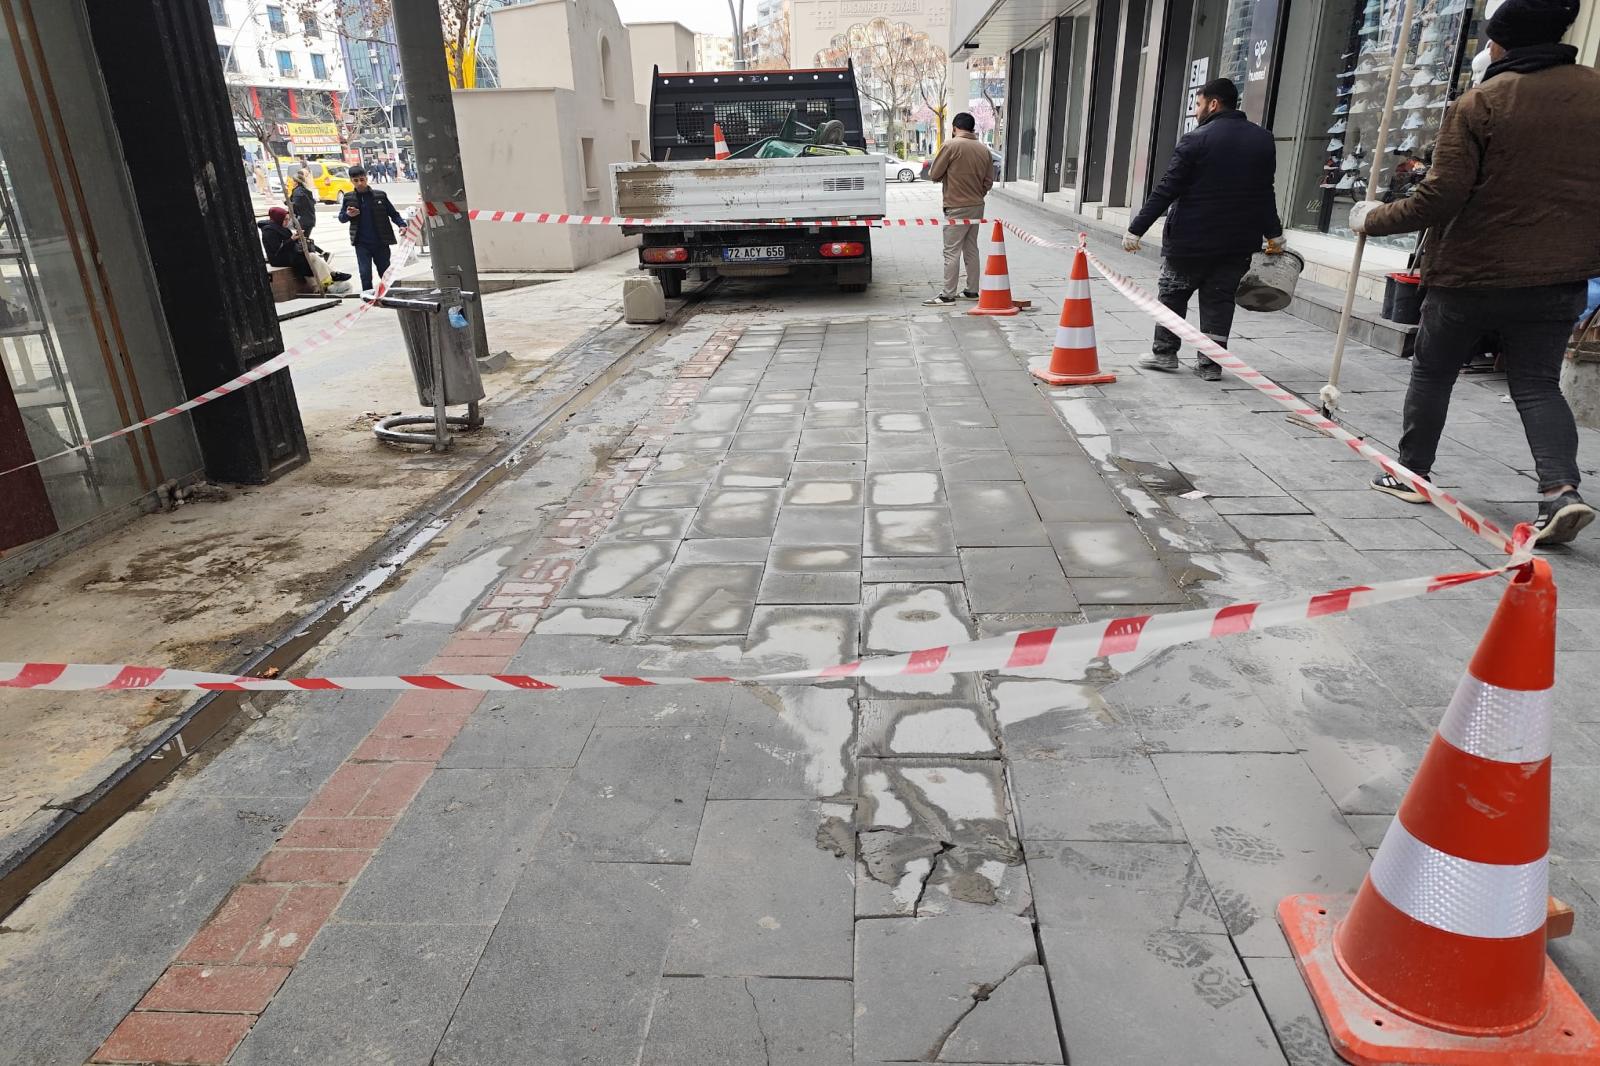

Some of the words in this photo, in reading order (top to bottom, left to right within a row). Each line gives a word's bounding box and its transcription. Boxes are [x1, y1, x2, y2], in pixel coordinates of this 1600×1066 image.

[1192, 64, 1198, 82] 3
[1188, 94, 1194, 111] 2
[729, 248, 740, 258] 72
[744, 247, 762, 258] ACY
[766, 246, 784, 257] 656
